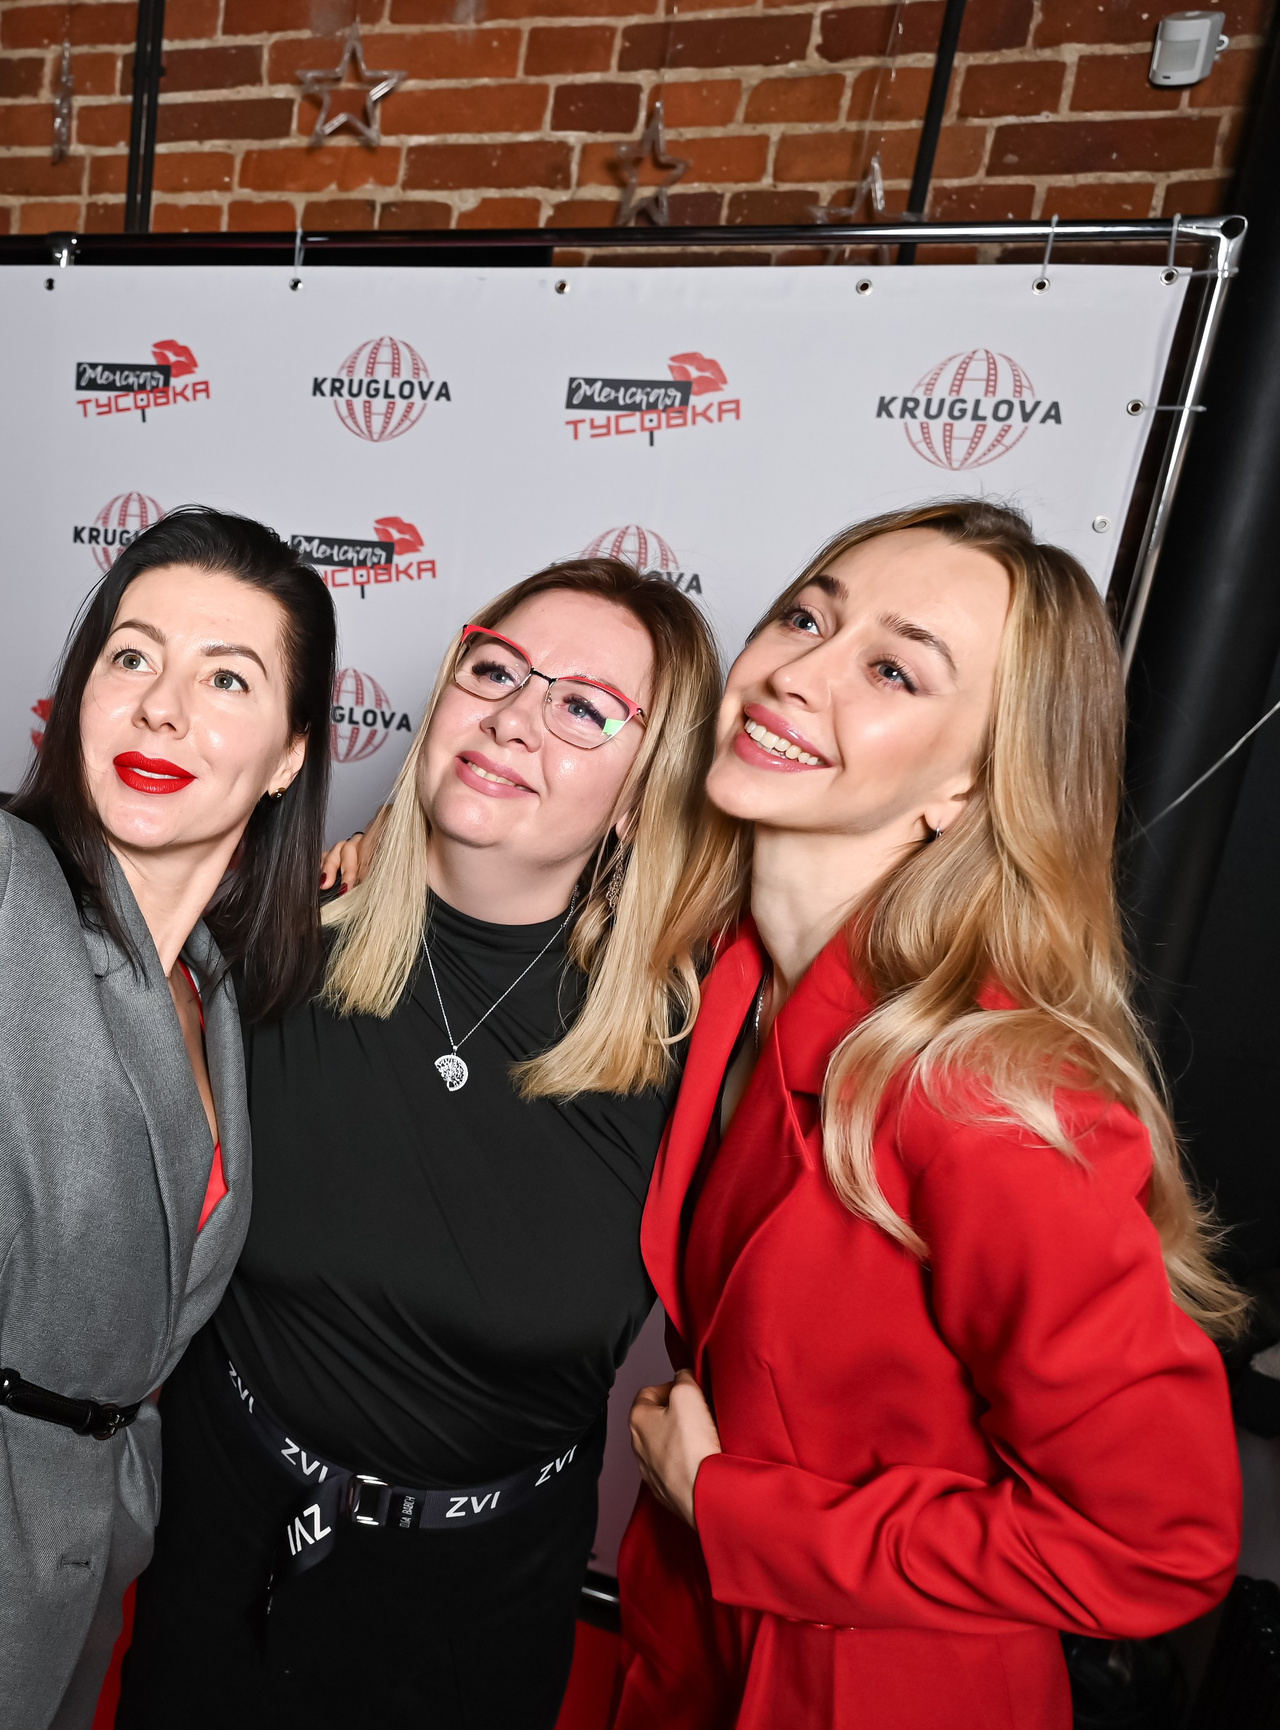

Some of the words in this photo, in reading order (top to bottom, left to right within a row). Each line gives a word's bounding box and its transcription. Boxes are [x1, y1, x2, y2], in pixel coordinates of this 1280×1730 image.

[76, 380, 211, 418] ТУСОВКА
[312, 377, 451, 401] KRUGLOVA
[565, 399, 740, 441] ТУСОВКА
[876, 396, 1062, 425] KRUGLOVA
[73, 526, 139, 547] KRUG
[331, 706, 412, 732] GLOVA
[281, 1437, 328, 1483] ZVI
[534, 1444, 578, 1487] ZVI
[445, 1491, 501, 1518] ZVI
[287, 1503, 332, 1556] ZVI
